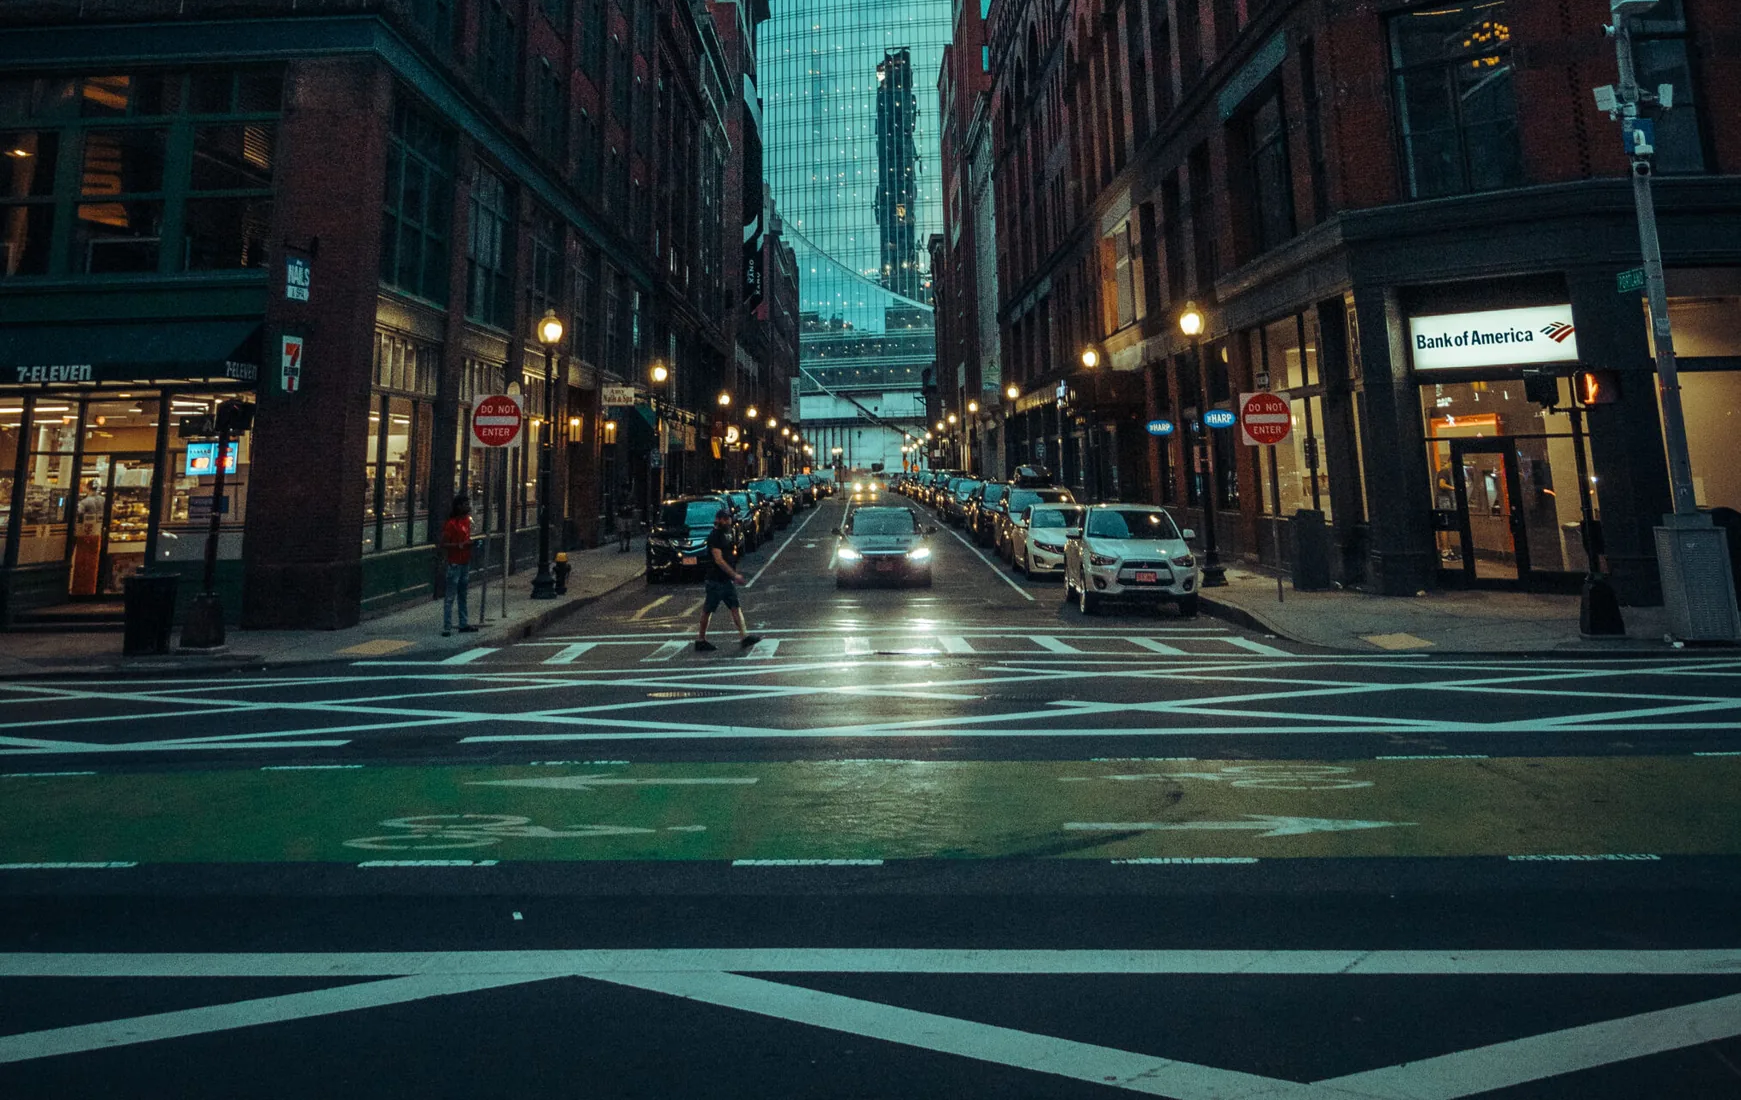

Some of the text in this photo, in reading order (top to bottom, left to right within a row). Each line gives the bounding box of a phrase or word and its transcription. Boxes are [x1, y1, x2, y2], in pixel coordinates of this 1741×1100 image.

[287, 264, 310, 287] NAILS
[1416, 327, 1534, 349] Bank of America
[481, 405, 516, 414] DO NOT
[1248, 403, 1283, 412] DO NOT
[1211, 413, 1232, 423] HARP
[482, 428, 510, 436] ENTER
[1153, 424, 1170, 432] HARP
[1253, 426, 1282, 435] ENTER
